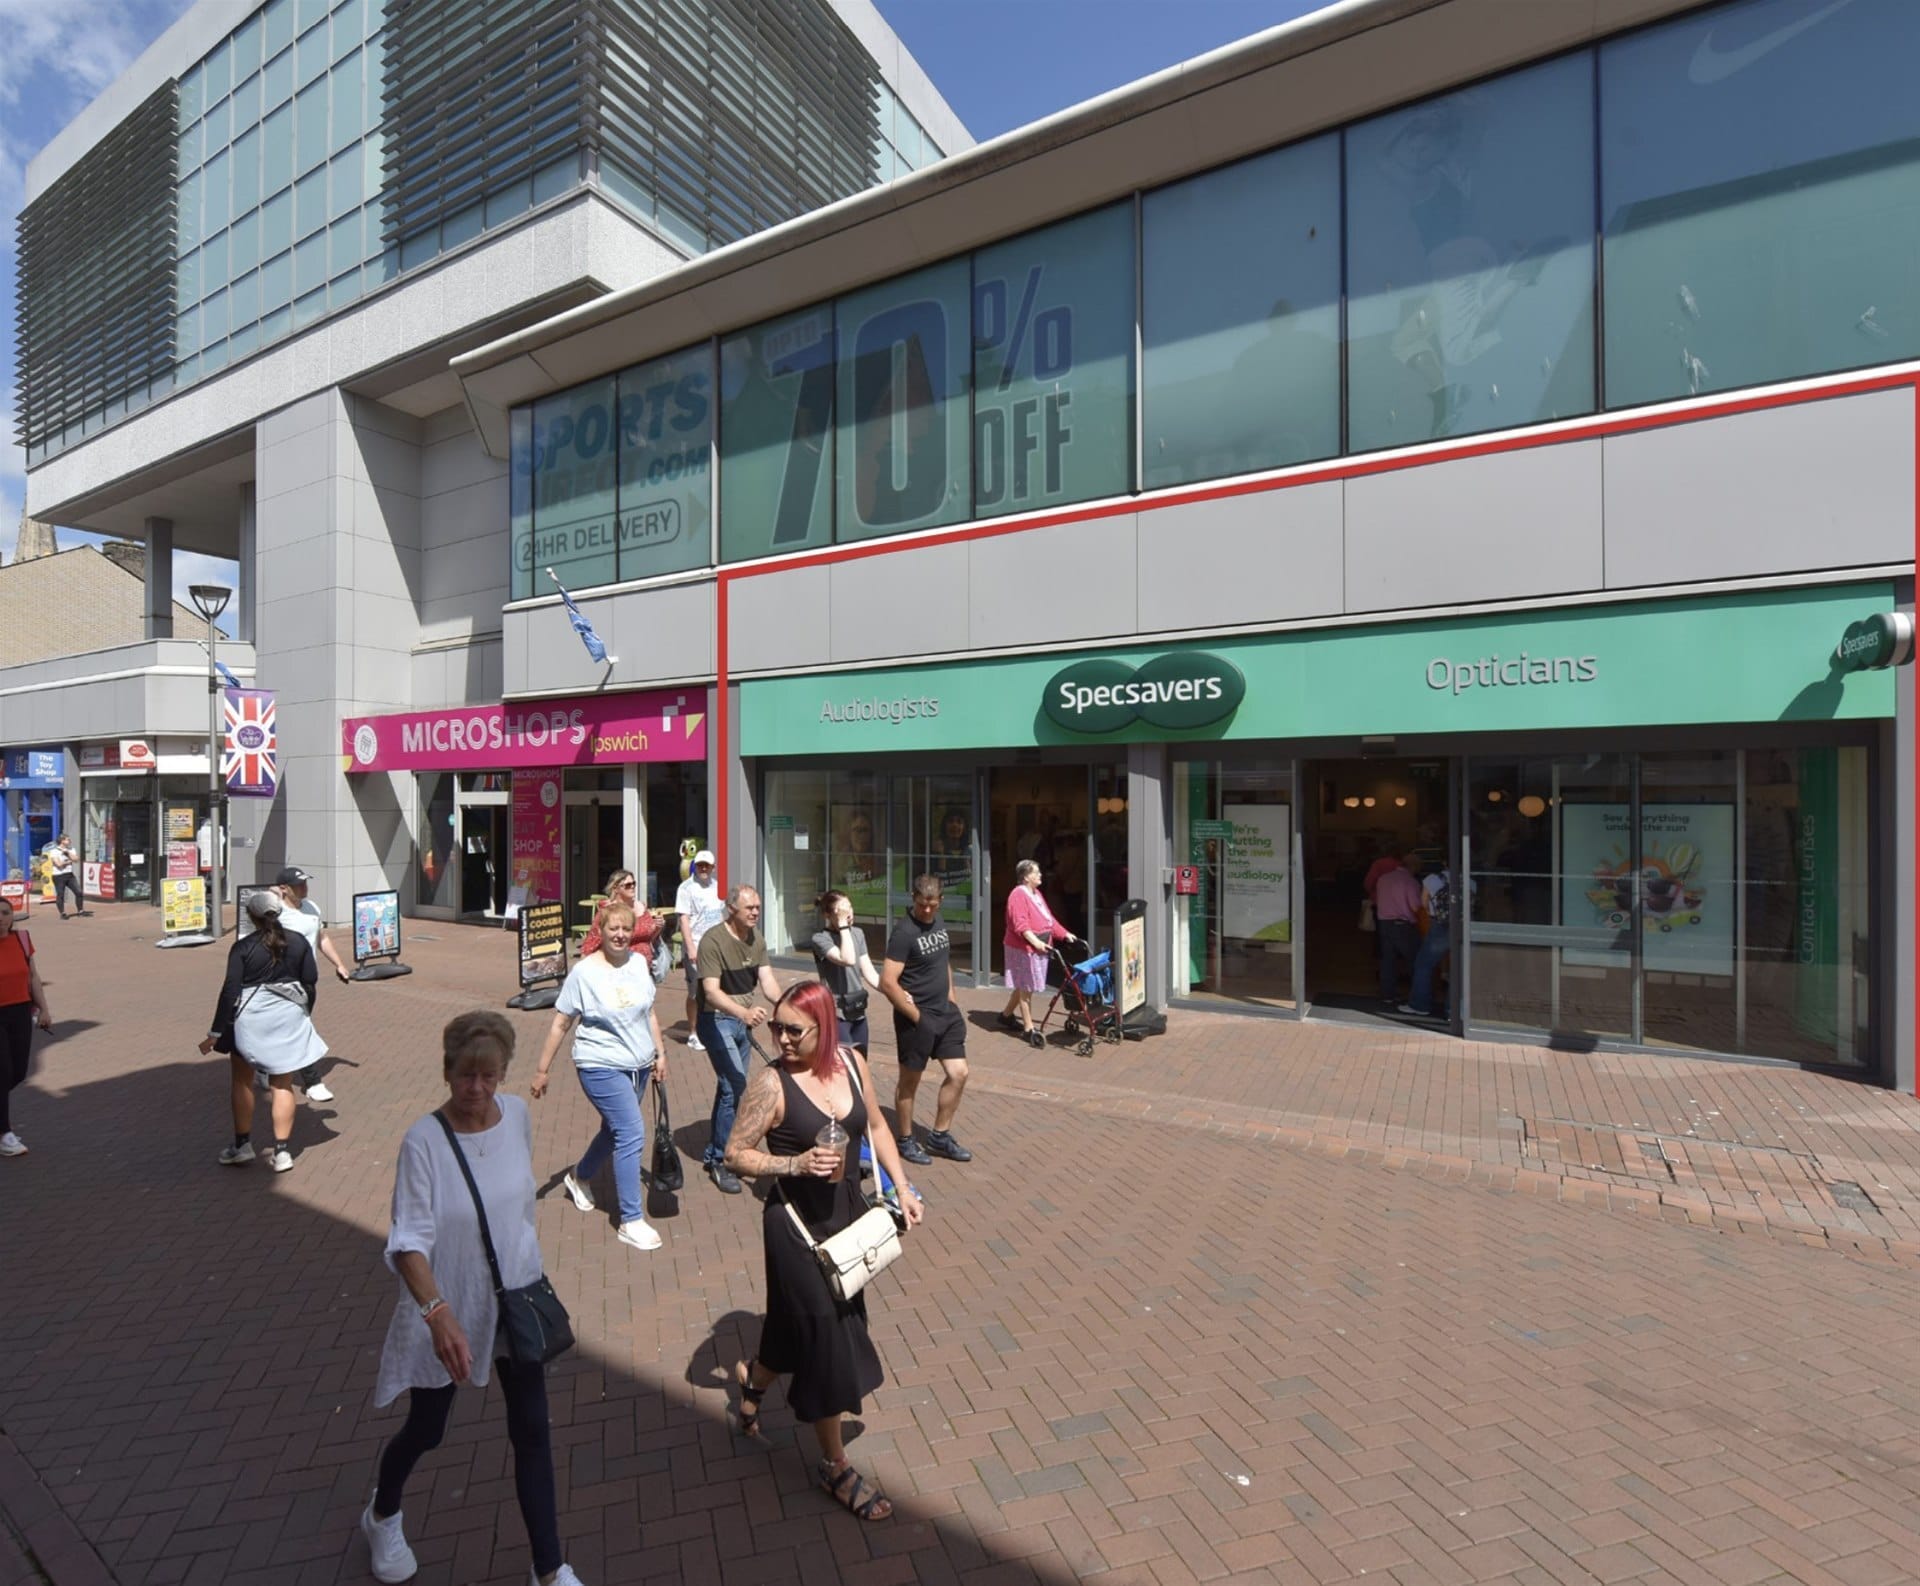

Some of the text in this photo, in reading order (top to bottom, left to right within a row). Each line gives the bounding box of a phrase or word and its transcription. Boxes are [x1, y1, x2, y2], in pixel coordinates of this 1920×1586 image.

[516, 373, 708, 475] SPORTS
[974, 391, 1072, 506] OFF
[522, 507, 673, 562] 24HR DELIVERY
[1843, 630, 1880, 658] Specsavers
[1426, 651, 1599, 695] Opticians
[1060, 676, 1223, 714] Specsavers
[819, 695, 940, 725] Audiologists
[402, 709, 587, 753] MICROSHOPS
[590, 731, 649, 757] Ipswich
[39, 754, 54, 762] The
[39, 761, 54, 770] Toy
[35, 768, 57, 777] Shop
[513, 840, 544, 853] SHOP
[1228, 848, 1248, 857] the
[1227, 871, 1284, 883] audiology
[1800, 814, 1815, 966] Contact Lenses
[915, 928, 949, 951] BOSS
